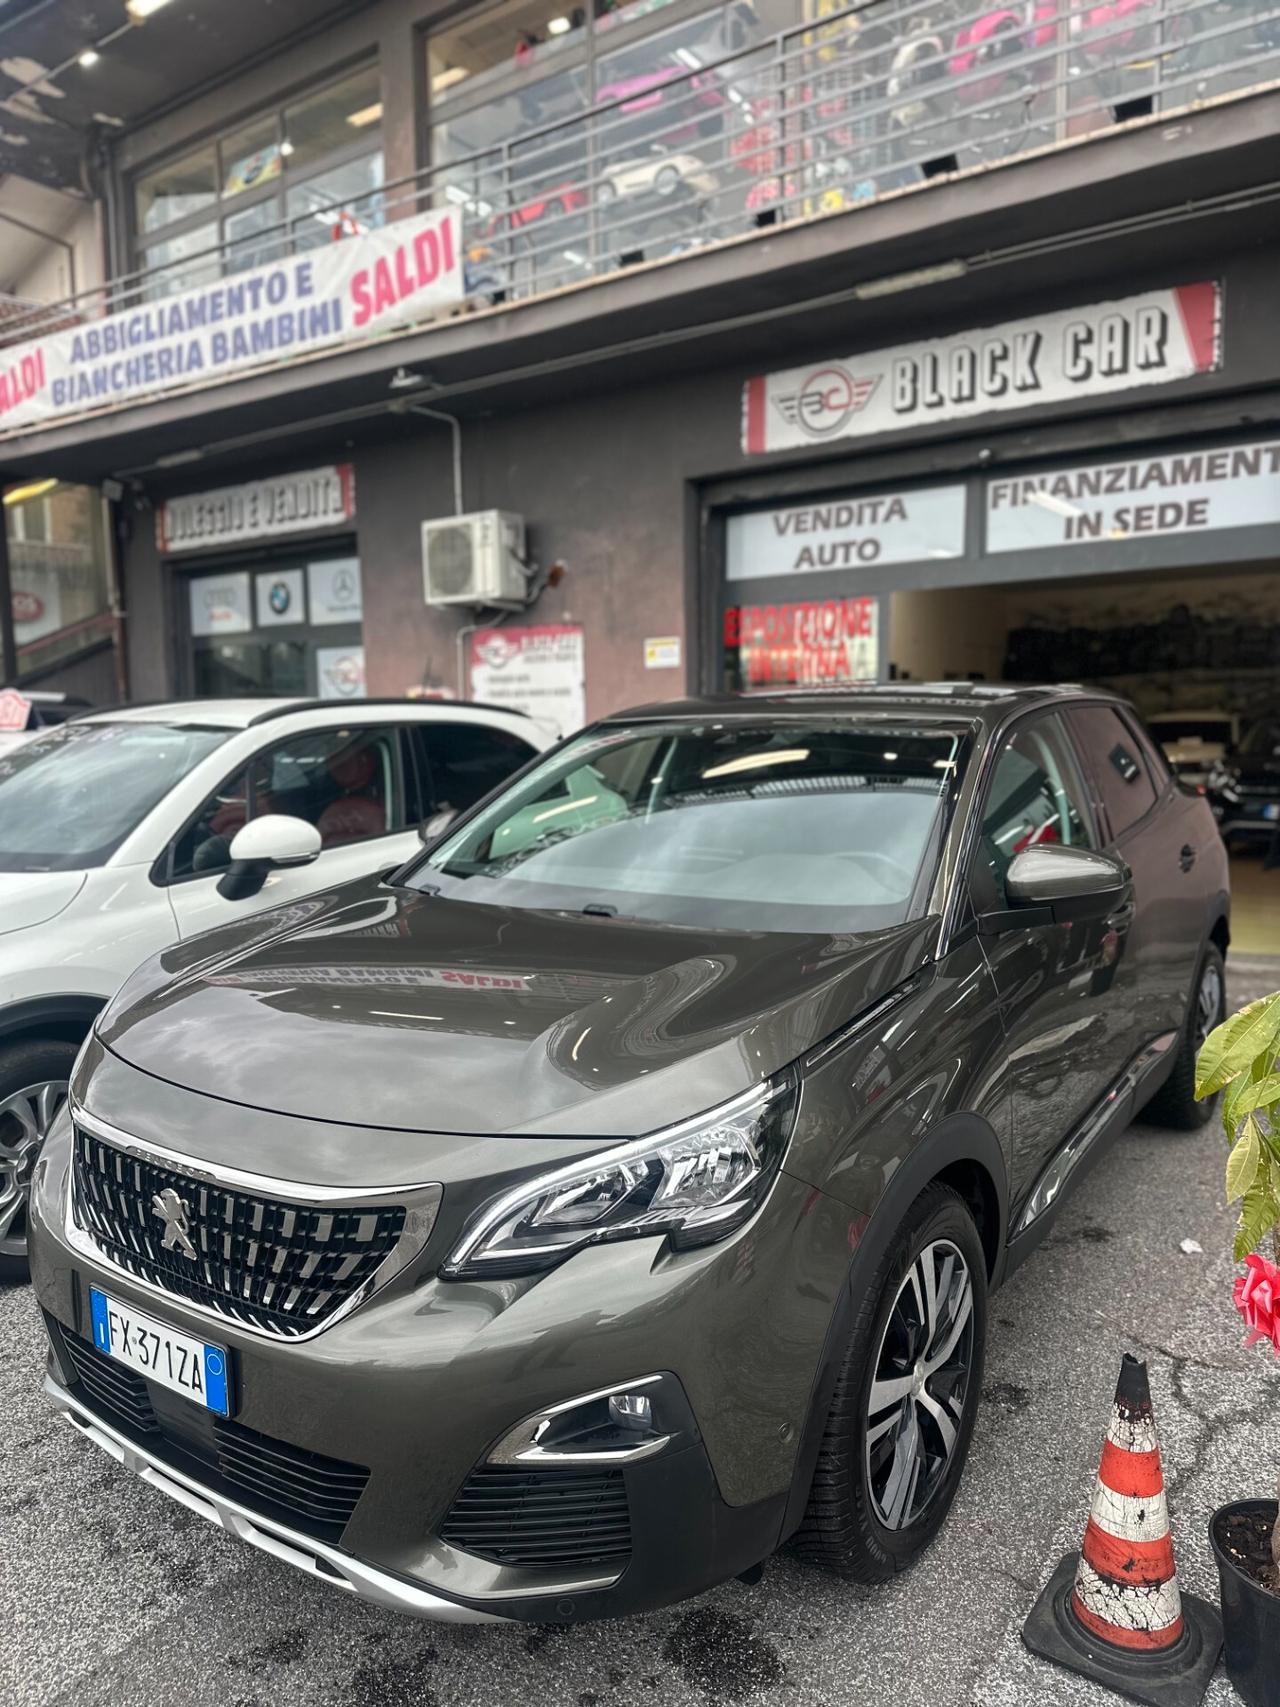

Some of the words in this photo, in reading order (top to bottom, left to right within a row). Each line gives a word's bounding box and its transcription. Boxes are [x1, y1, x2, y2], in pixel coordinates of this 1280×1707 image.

[350, 215, 454, 328] SALDI
[69, 271, 287, 364] ABBIGLIAMENTO
[296, 261, 314, 296] E
[51, 339, 204, 407] BIANCHERIA
[211, 298, 343, 365] BAMBINI
[892, 330, 1042, 414] BLACK
[1063, 305, 1169, 382] CAR
[773, 497, 908, 538] VENDITA
[794, 537, 882, 569] AUTO
[1064, 510, 1103, 540] IN
[1112, 498, 1210, 533] SEDE
[133, 1147, 209, 1181] PEUGEOT
